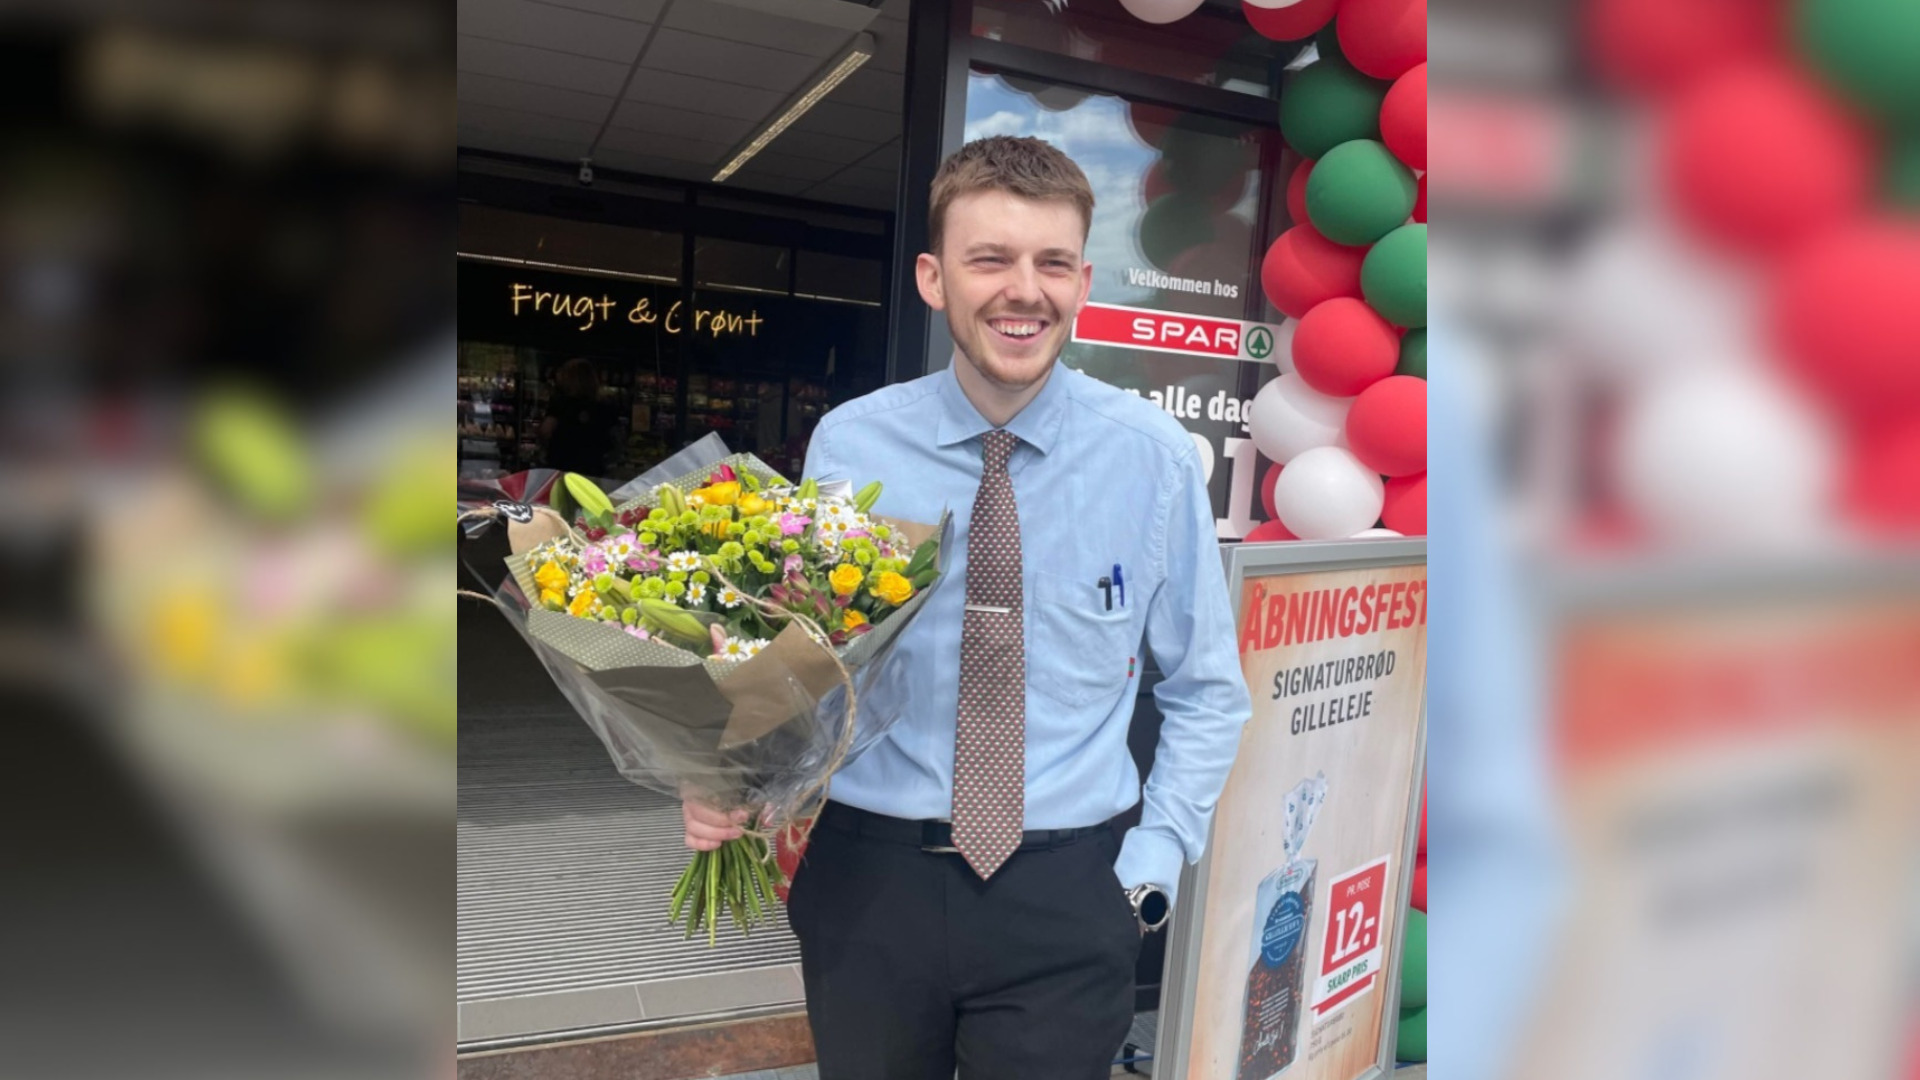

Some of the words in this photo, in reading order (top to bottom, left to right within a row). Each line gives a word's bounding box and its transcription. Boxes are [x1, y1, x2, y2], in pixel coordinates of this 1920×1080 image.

[1129, 267, 1211, 294] Velkommen
[1213, 279, 1239, 298] hos
[511, 283, 616, 331] Frugt
[628, 297, 657, 324] &
[1132, 318, 1238, 350] SPAR
[1149, 385, 1202, 419] alle
[1272, 650, 1396, 700] SIGNATURBRØD
[1291, 691, 1373, 735] GILLELEJE
[1327, 967, 1351, 993] SKARP
[1351, 959, 1368, 981] PRIS
